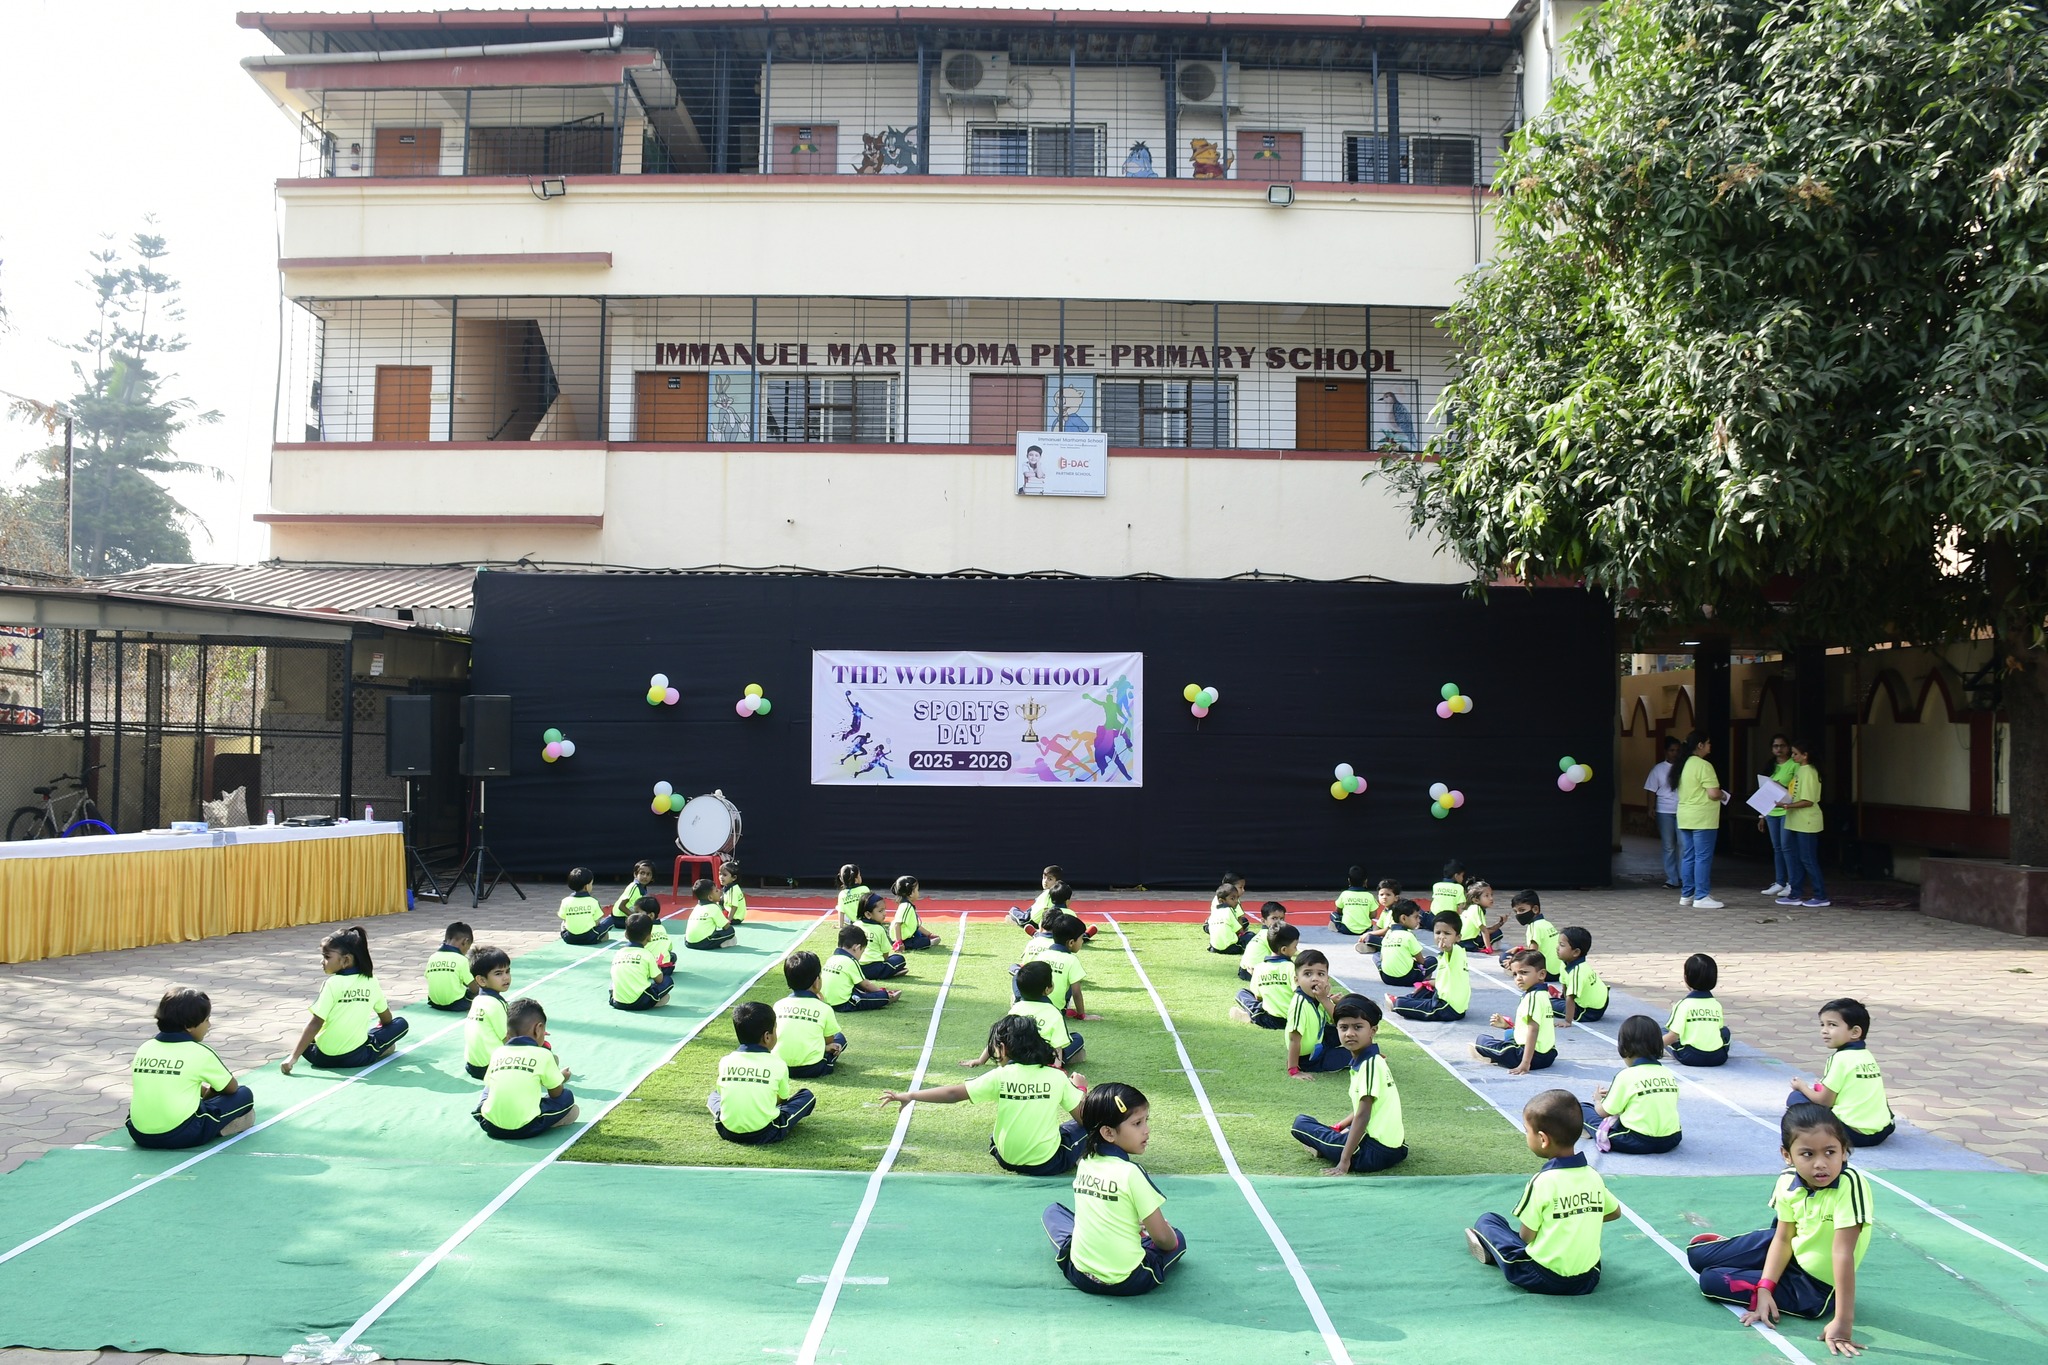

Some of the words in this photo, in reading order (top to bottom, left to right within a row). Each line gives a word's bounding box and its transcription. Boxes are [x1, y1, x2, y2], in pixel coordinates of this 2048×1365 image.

[655, 342, 818, 366] IMMANUEL
[827, 343, 898, 366] MAR
[912, 343, 1021, 366] THOMA
[1030, 343, 1257, 369] PRE-PRIMARY
[1265, 347, 1402, 373] SCHOOL
[831, 665, 888, 684] THE
[893, 666, 994, 685] WORLD
[1000, 666, 1109, 687] SCHOOL
[913, 700, 1010, 721] SPORTS
[937, 724, 986, 745] DAY
[913, 753, 953, 769] 2025
[968, 754, 1009, 770] 2026
[431, 961, 457, 969] WORLD
[1260, 973, 1288, 981] WORLD
[343, 988, 371, 998] WORLD
[784, 1006, 821, 1019] WORLD
[140, 1057, 185, 1070] WORLD
[496, 1056, 538, 1068] WORLD
[727, 1066, 771, 1079] WORLD
[1006, 1082, 1051, 1095] WORLD
[1078, 1174, 1118, 1194] WORLD
